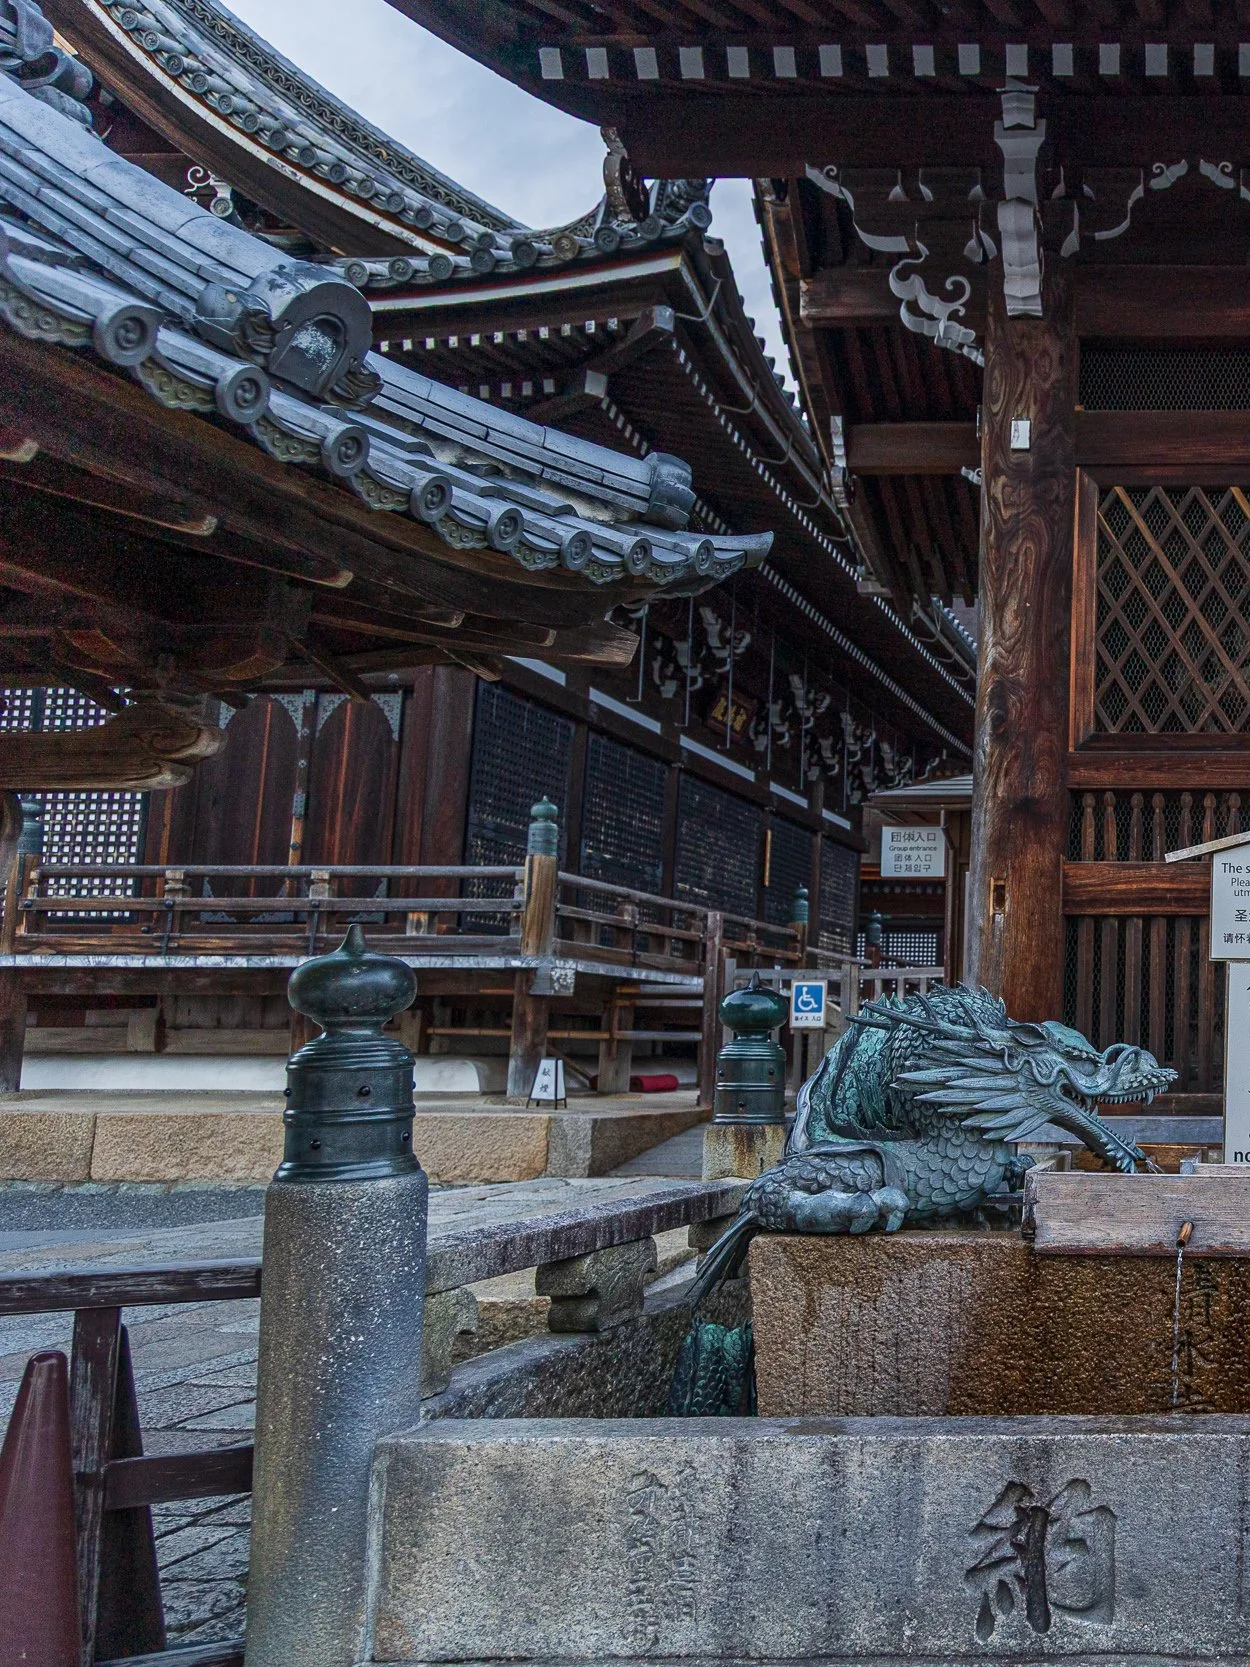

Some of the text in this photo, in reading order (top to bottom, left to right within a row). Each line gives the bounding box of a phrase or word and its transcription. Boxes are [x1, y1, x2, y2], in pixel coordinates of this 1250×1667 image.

[891, 832, 936, 842] 団体入口
[1221, 862, 1243, 874] The
